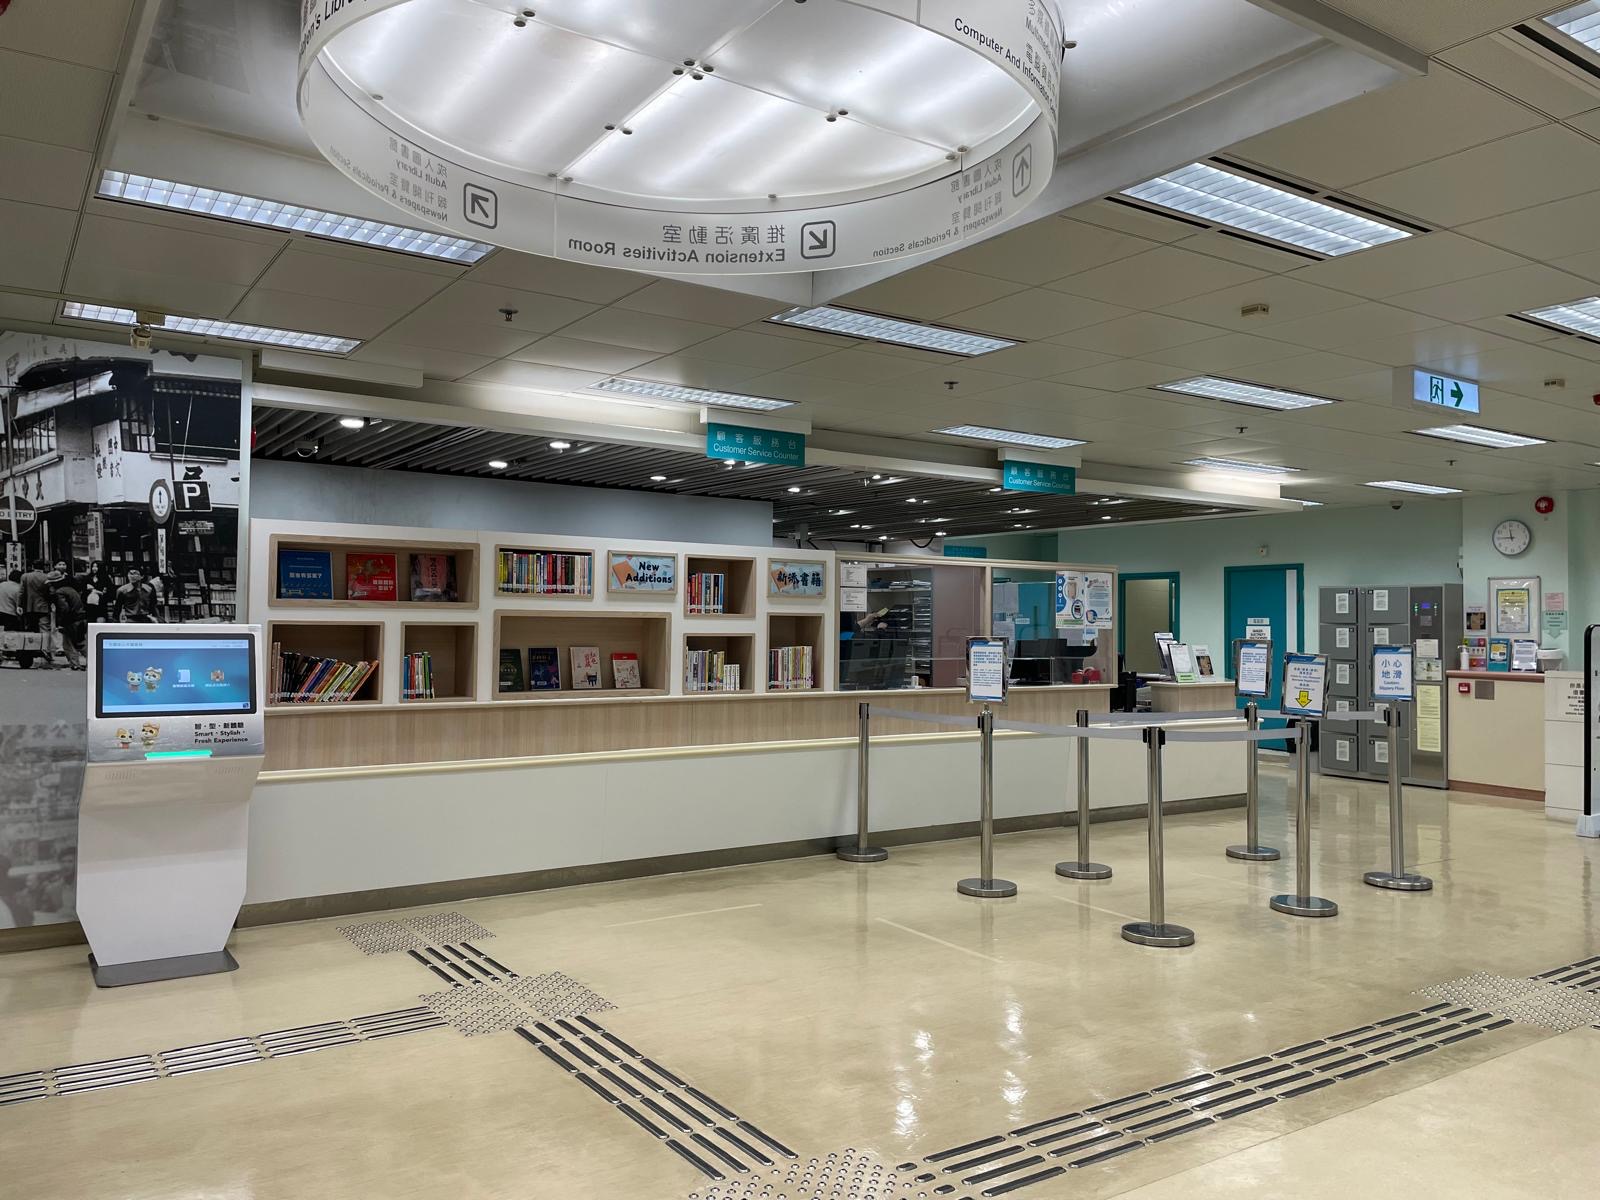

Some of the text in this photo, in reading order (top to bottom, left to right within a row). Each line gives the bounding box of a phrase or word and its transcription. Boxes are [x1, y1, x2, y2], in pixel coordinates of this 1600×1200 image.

[954, 18, 1003, 54] Computer
[1005, 48, 1020, 69] And
[713, 443, 800, 460] Customer Service Counter
[1008, 476, 1033, 486] Customer
[1033, 479, 1052, 488] Service
[638, 561, 660, 572] New
[625, 572, 673, 584] Additions
[1381, 658, 1403, 668] 小心
[1381, 669, 1403, 680] 地滑
